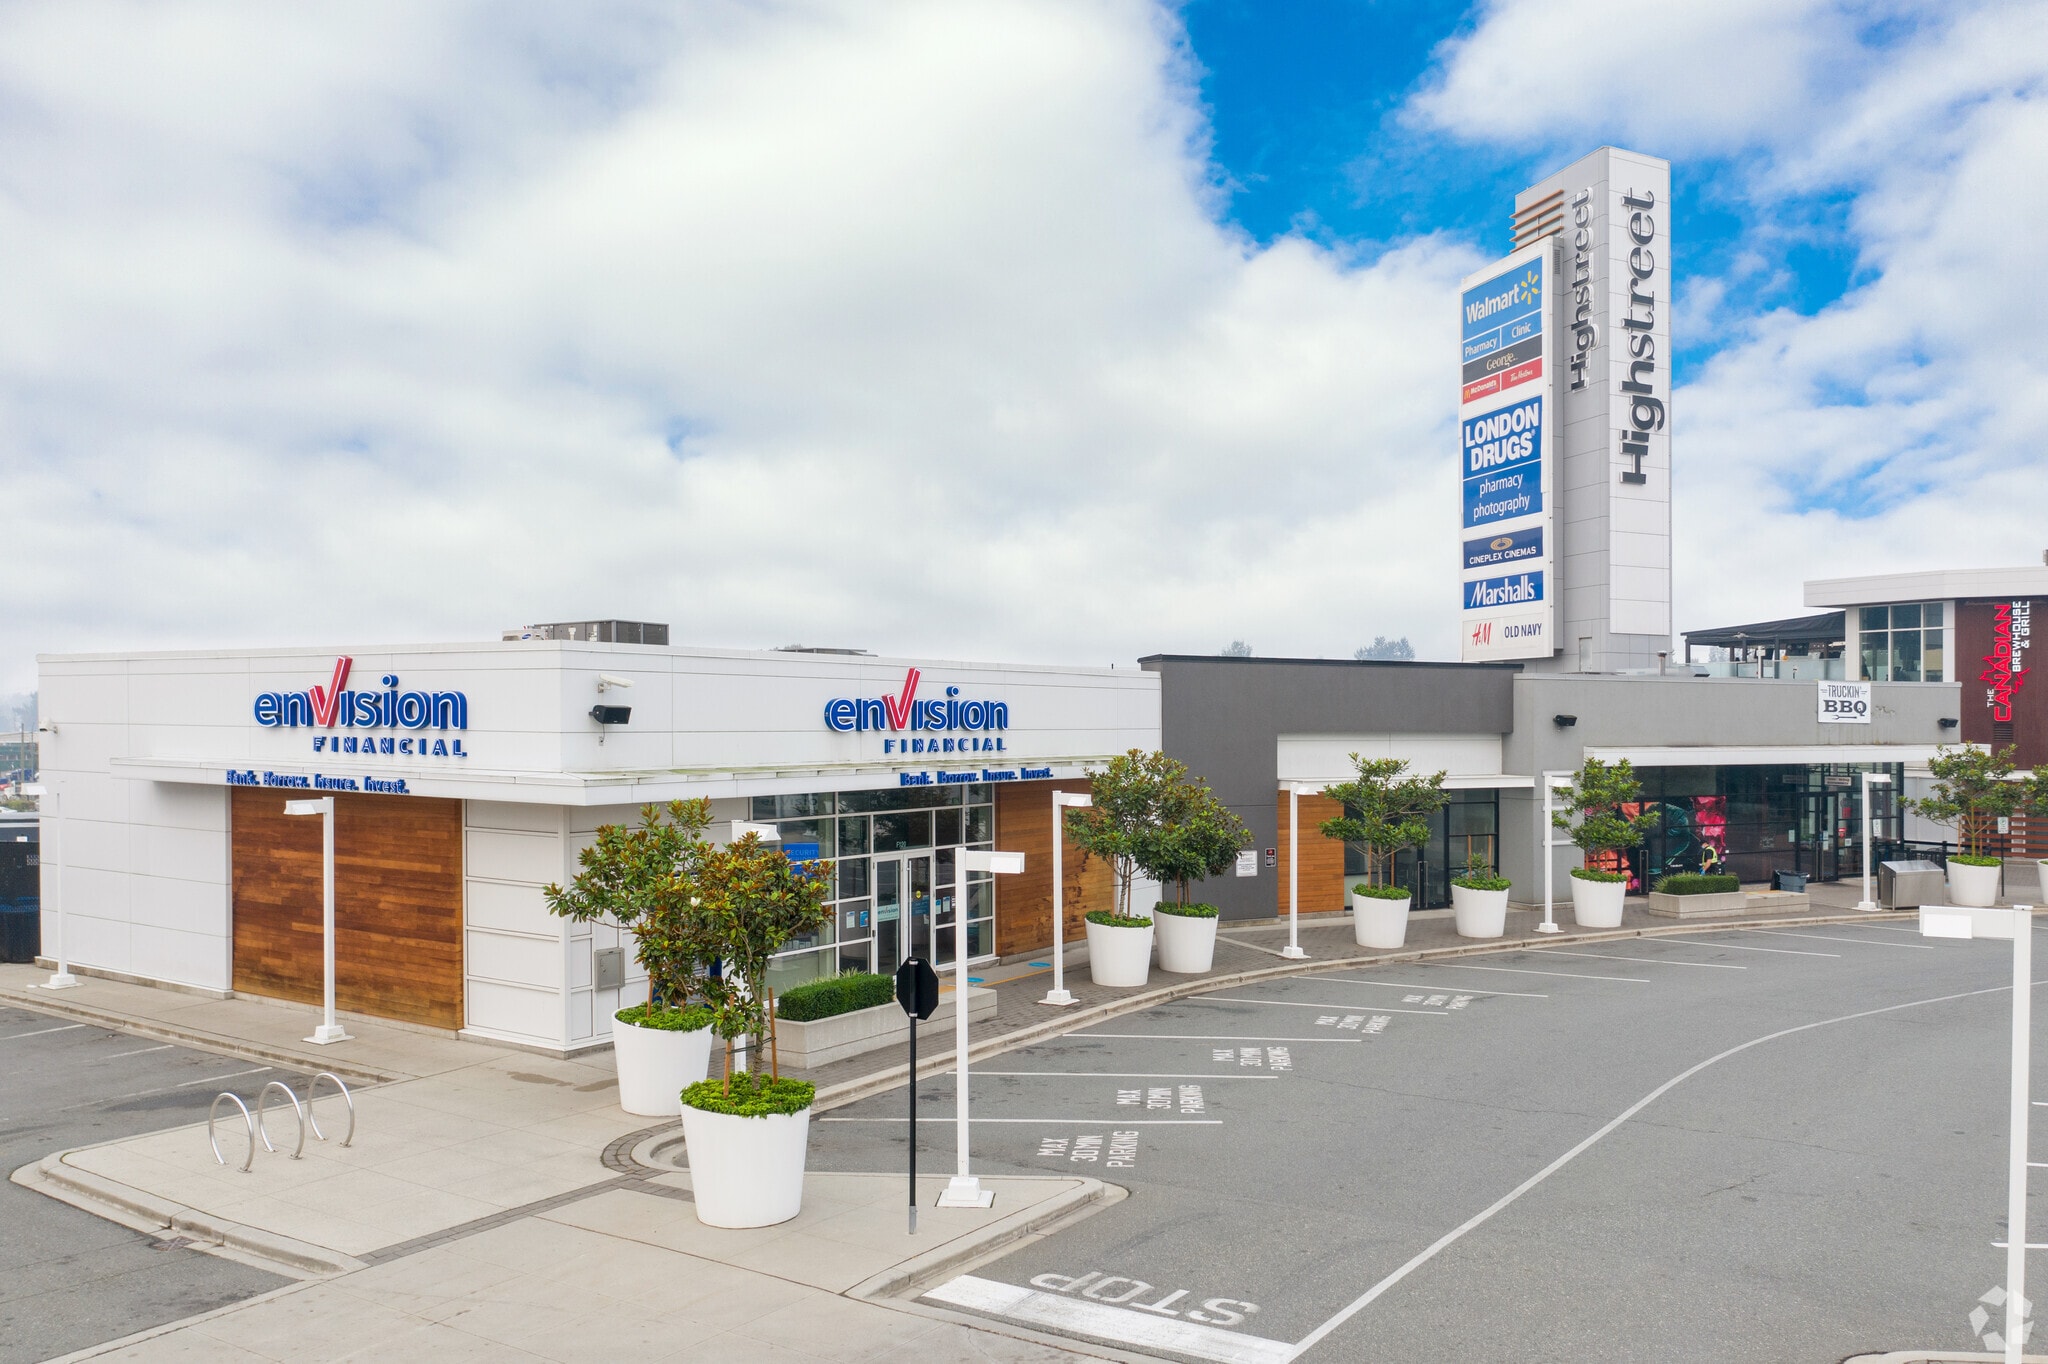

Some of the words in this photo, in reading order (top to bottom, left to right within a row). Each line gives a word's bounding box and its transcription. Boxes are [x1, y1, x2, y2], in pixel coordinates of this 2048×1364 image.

[1570, 187, 1600, 393] Highstreet
[1466, 284, 1520, 325] Walmart
[1511, 322, 1532, 339] Clinic
[1619, 187, 1666, 485] Highstreet
[1465, 337, 1498, 358] Pharmacy
[1465, 402, 1539, 448] LONDON
[1471, 431, 1534, 471] DRUGS
[1479, 473, 1524, 498] pharmacy
[1473, 493, 1530, 522] photography
[1469, 552, 1503, 565] CINEPLEX
[1504, 546, 1537, 559] CINEMAS
[1470, 575, 1535, 607] Marshalls
[1504, 625, 1519, 638] OLD
[1521, 623, 1542, 637] NAVY
[2021, 600, 2030, 636] GRILL
[2012, 601, 2021, 673] BREWHOUSE
[2021, 639, 2030, 648] &
[1994, 604, 2012, 721] CANADIAN
[1823, 700, 1867, 716] BBQ
[1986, 688, 1995, 708] THE
[313, 735, 468, 757] FINANCIAL
[884, 737, 1007, 754] FINANCIAL
[226, 769, 260, 786] Bank.
[263, 771, 311, 788] Borrow.
[314, 773, 359, 791] Insure.
[364, 776, 410, 794] Invest.
[900, 771, 934, 787] Bank.
[937, 770, 979, 784] Borrow.
[982, 768, 1018, 782] Insure.
[1021, 767, 1054, 780] Invest.
[1116, 1089, 1141, 1105] MAX
[1178, 1084, 1206, 1114] PARKING
[1036, 1137, 1070, 1157] MAX
[1106, 1130, 1140, 1168] PARKING
[1029, 1271, 1262, 1326] STOP
